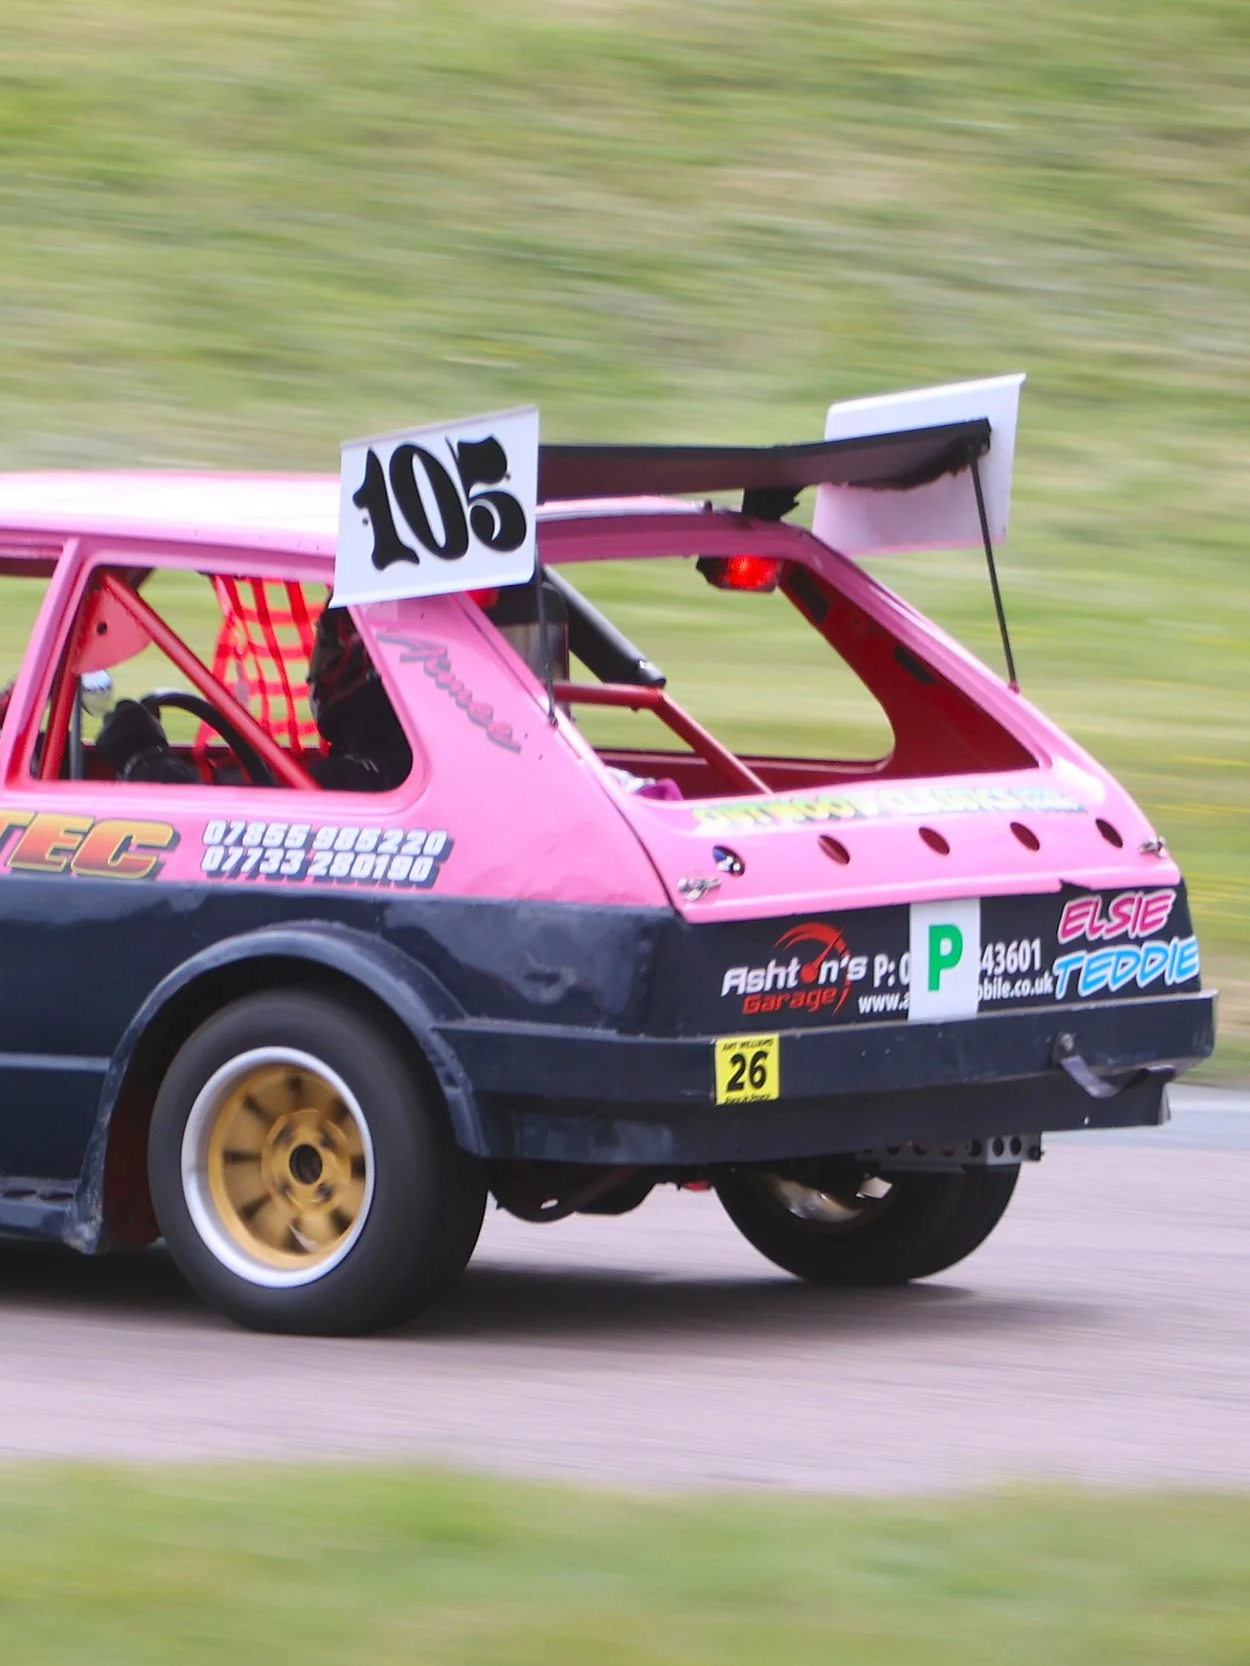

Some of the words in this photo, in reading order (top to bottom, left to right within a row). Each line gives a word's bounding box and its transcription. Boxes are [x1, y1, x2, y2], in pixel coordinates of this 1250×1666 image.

[352, 434, 527, 571] 105
[201, 845, 308, 875] 07733
[1057, 888, 1177, 945] ELSIE
[873, 953, 896, 988] P:
[979, 938, 1042, 977] 43601
[927, 924, 963, 993] P
[1052, 935, 1200, 1000] TEDDIE
[742, 986, 839, 1016] Garage
[726, 1050, 768, 1093] 26
